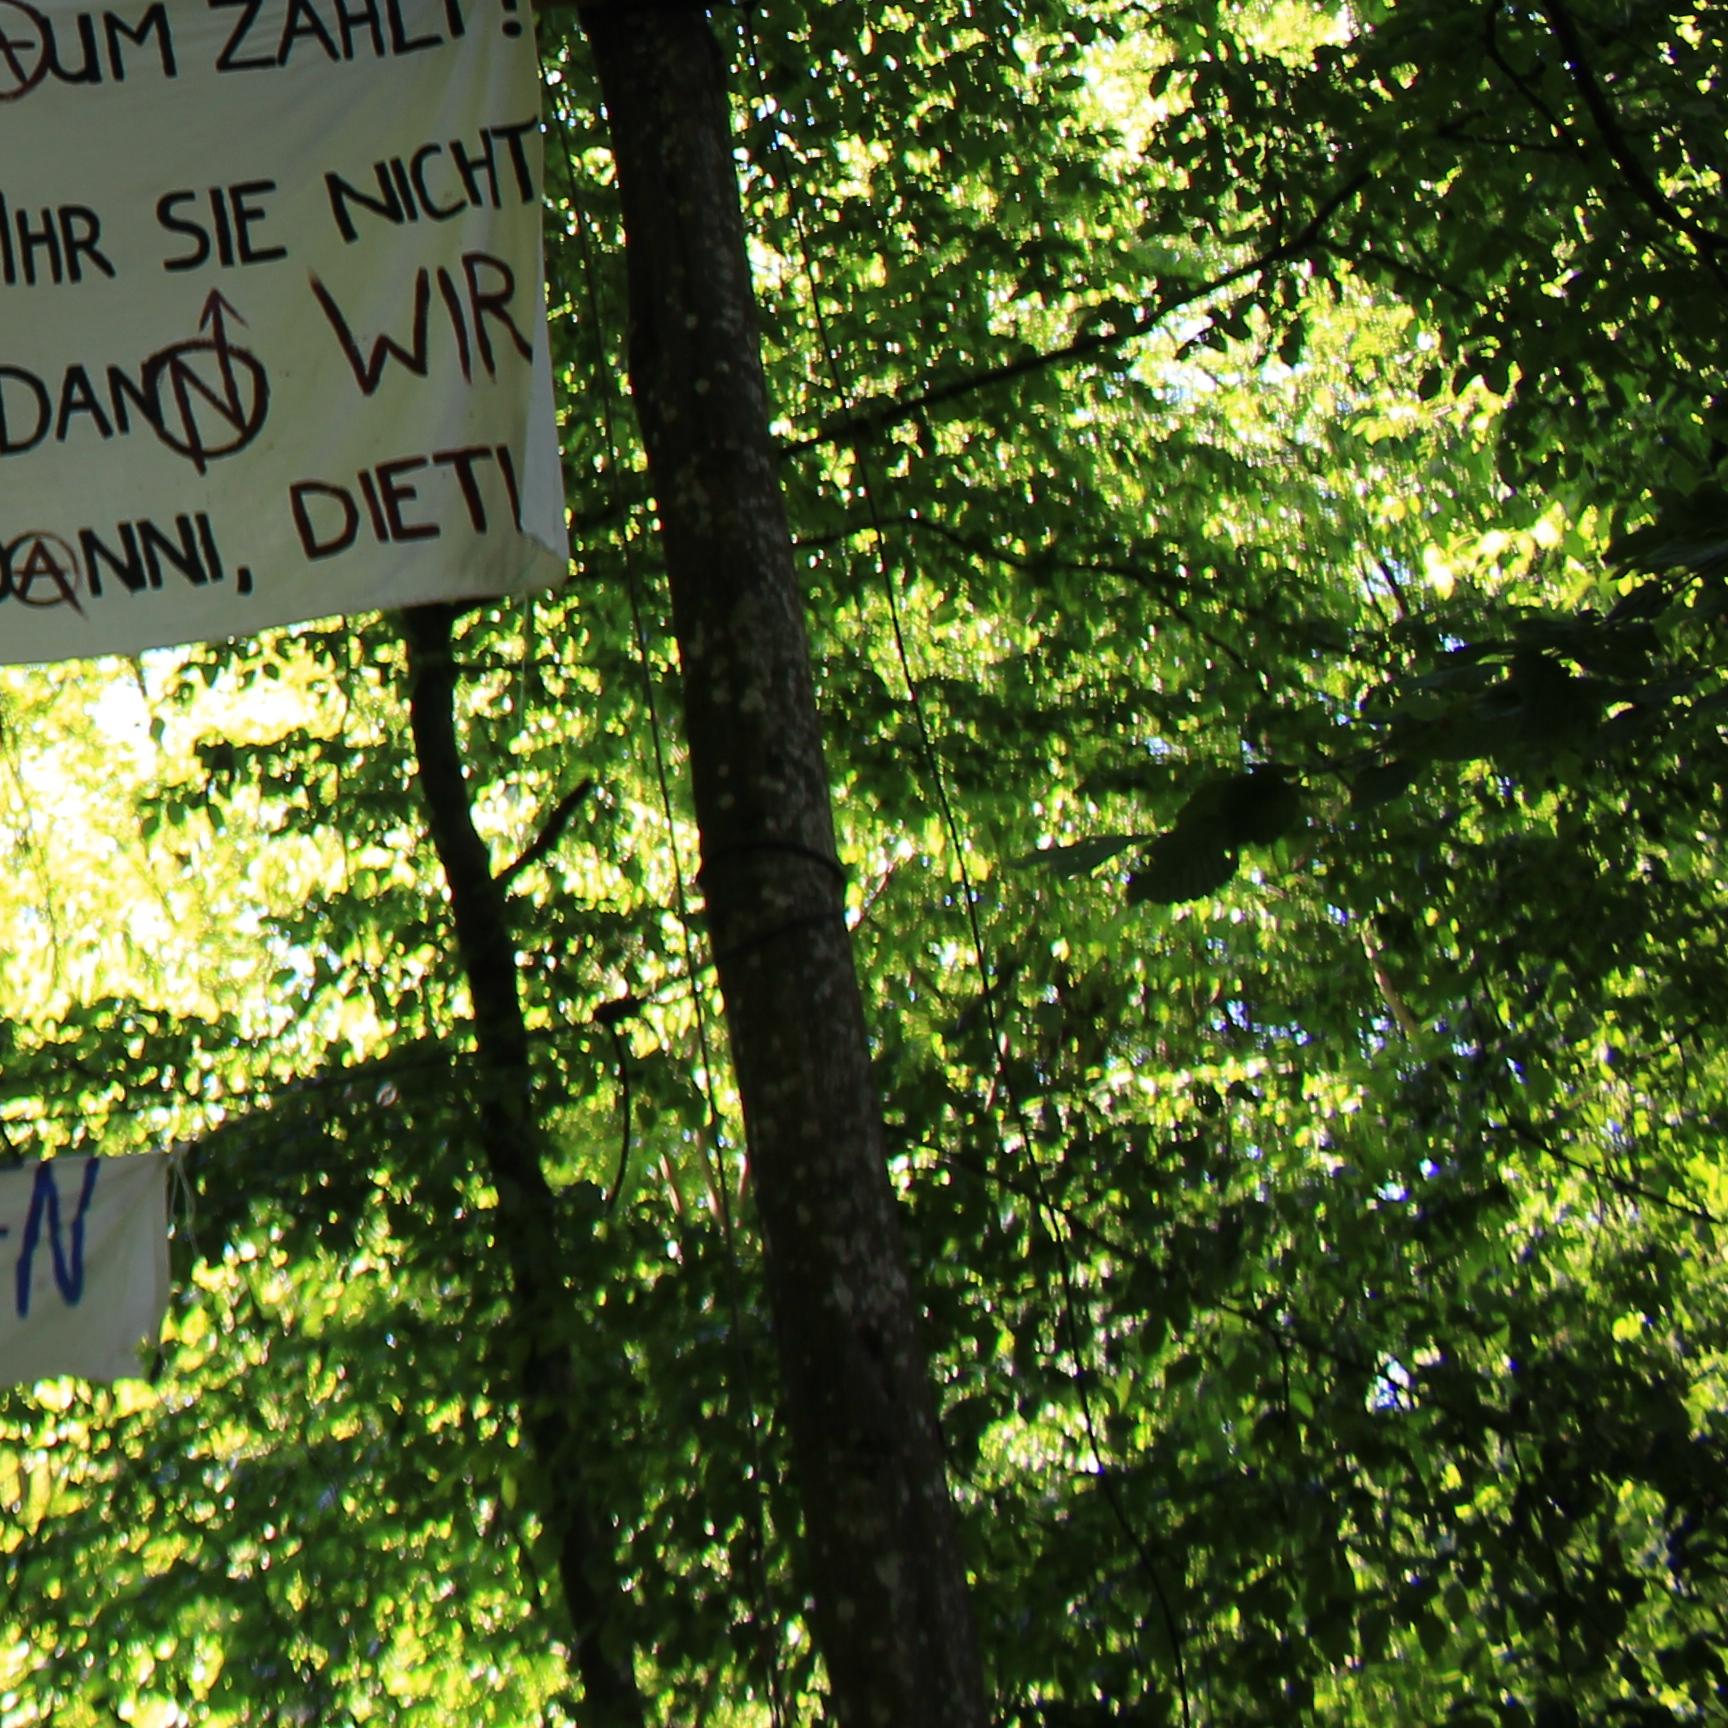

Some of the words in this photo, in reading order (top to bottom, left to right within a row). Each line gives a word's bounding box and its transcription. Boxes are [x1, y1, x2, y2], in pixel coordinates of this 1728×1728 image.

[155, 178, 289, 271] SIE
[324, 115, 540, 242] NICHT
[306, 250, 534, 398] WIR
